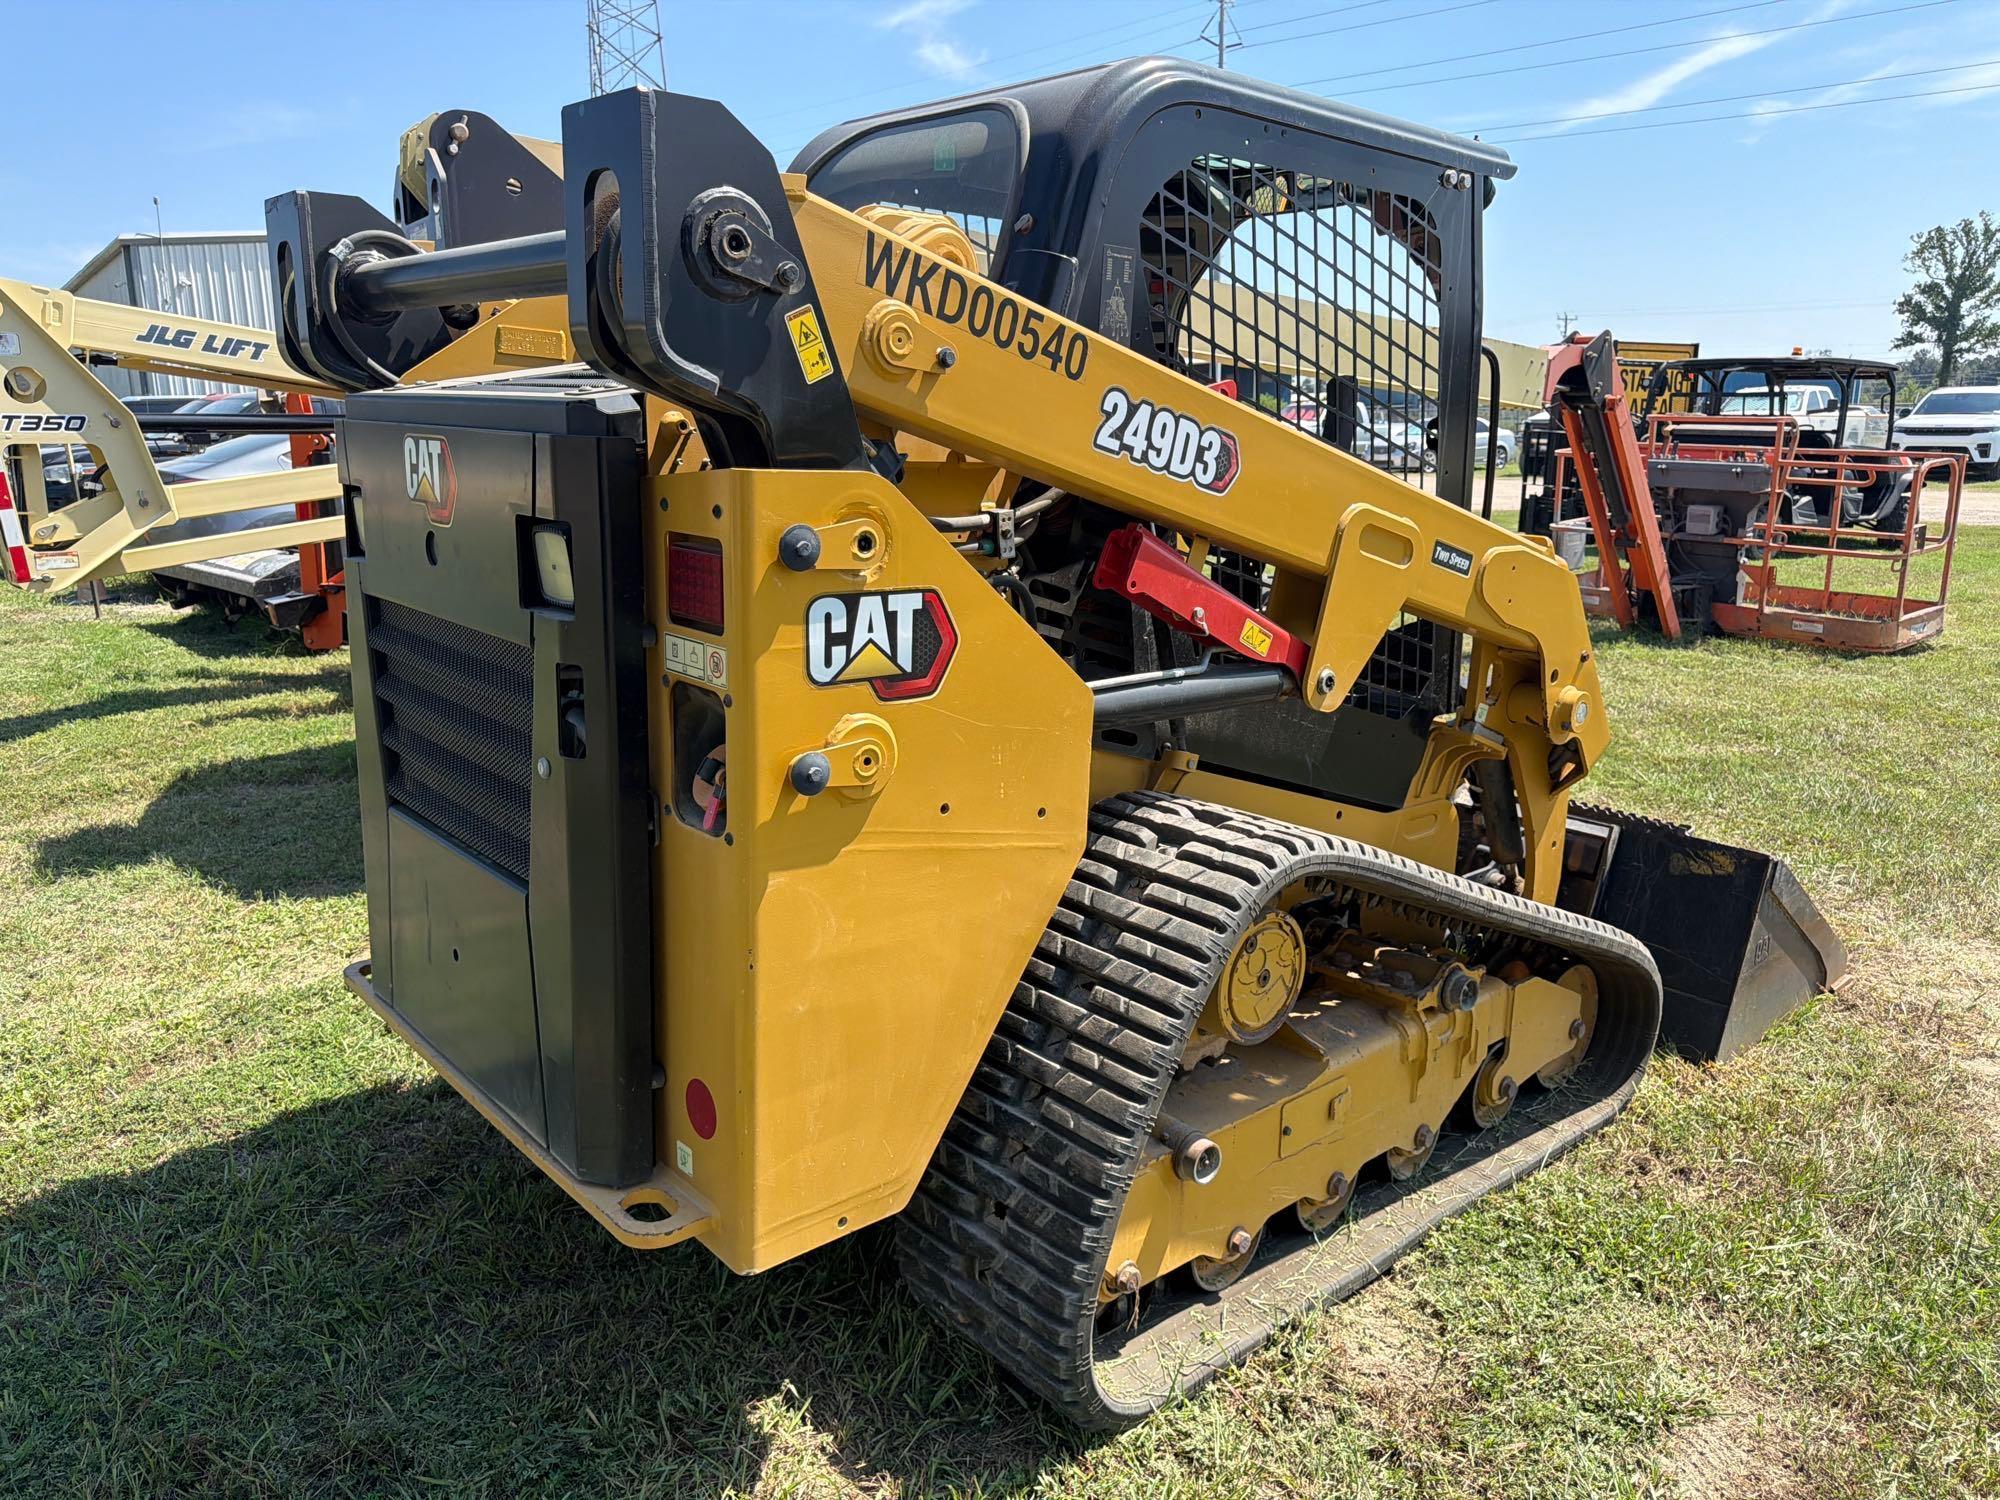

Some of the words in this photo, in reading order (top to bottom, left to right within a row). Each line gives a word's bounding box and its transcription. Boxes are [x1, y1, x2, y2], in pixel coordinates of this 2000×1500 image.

[865, 229, 1089, 382] WKD00540
[135, 323, 198, 350] JLG
[200, 333, 271, 361] LIFT
[1620, 368, 1684, 393] STANG
[1630, 397, 1668, 416] AA
[1, 414, 88, 433] T350
[1096, 390, 1222, 486] 249D3
[404, 436, 442, 504] CAT
[808, 592, 923, 683] CAT
